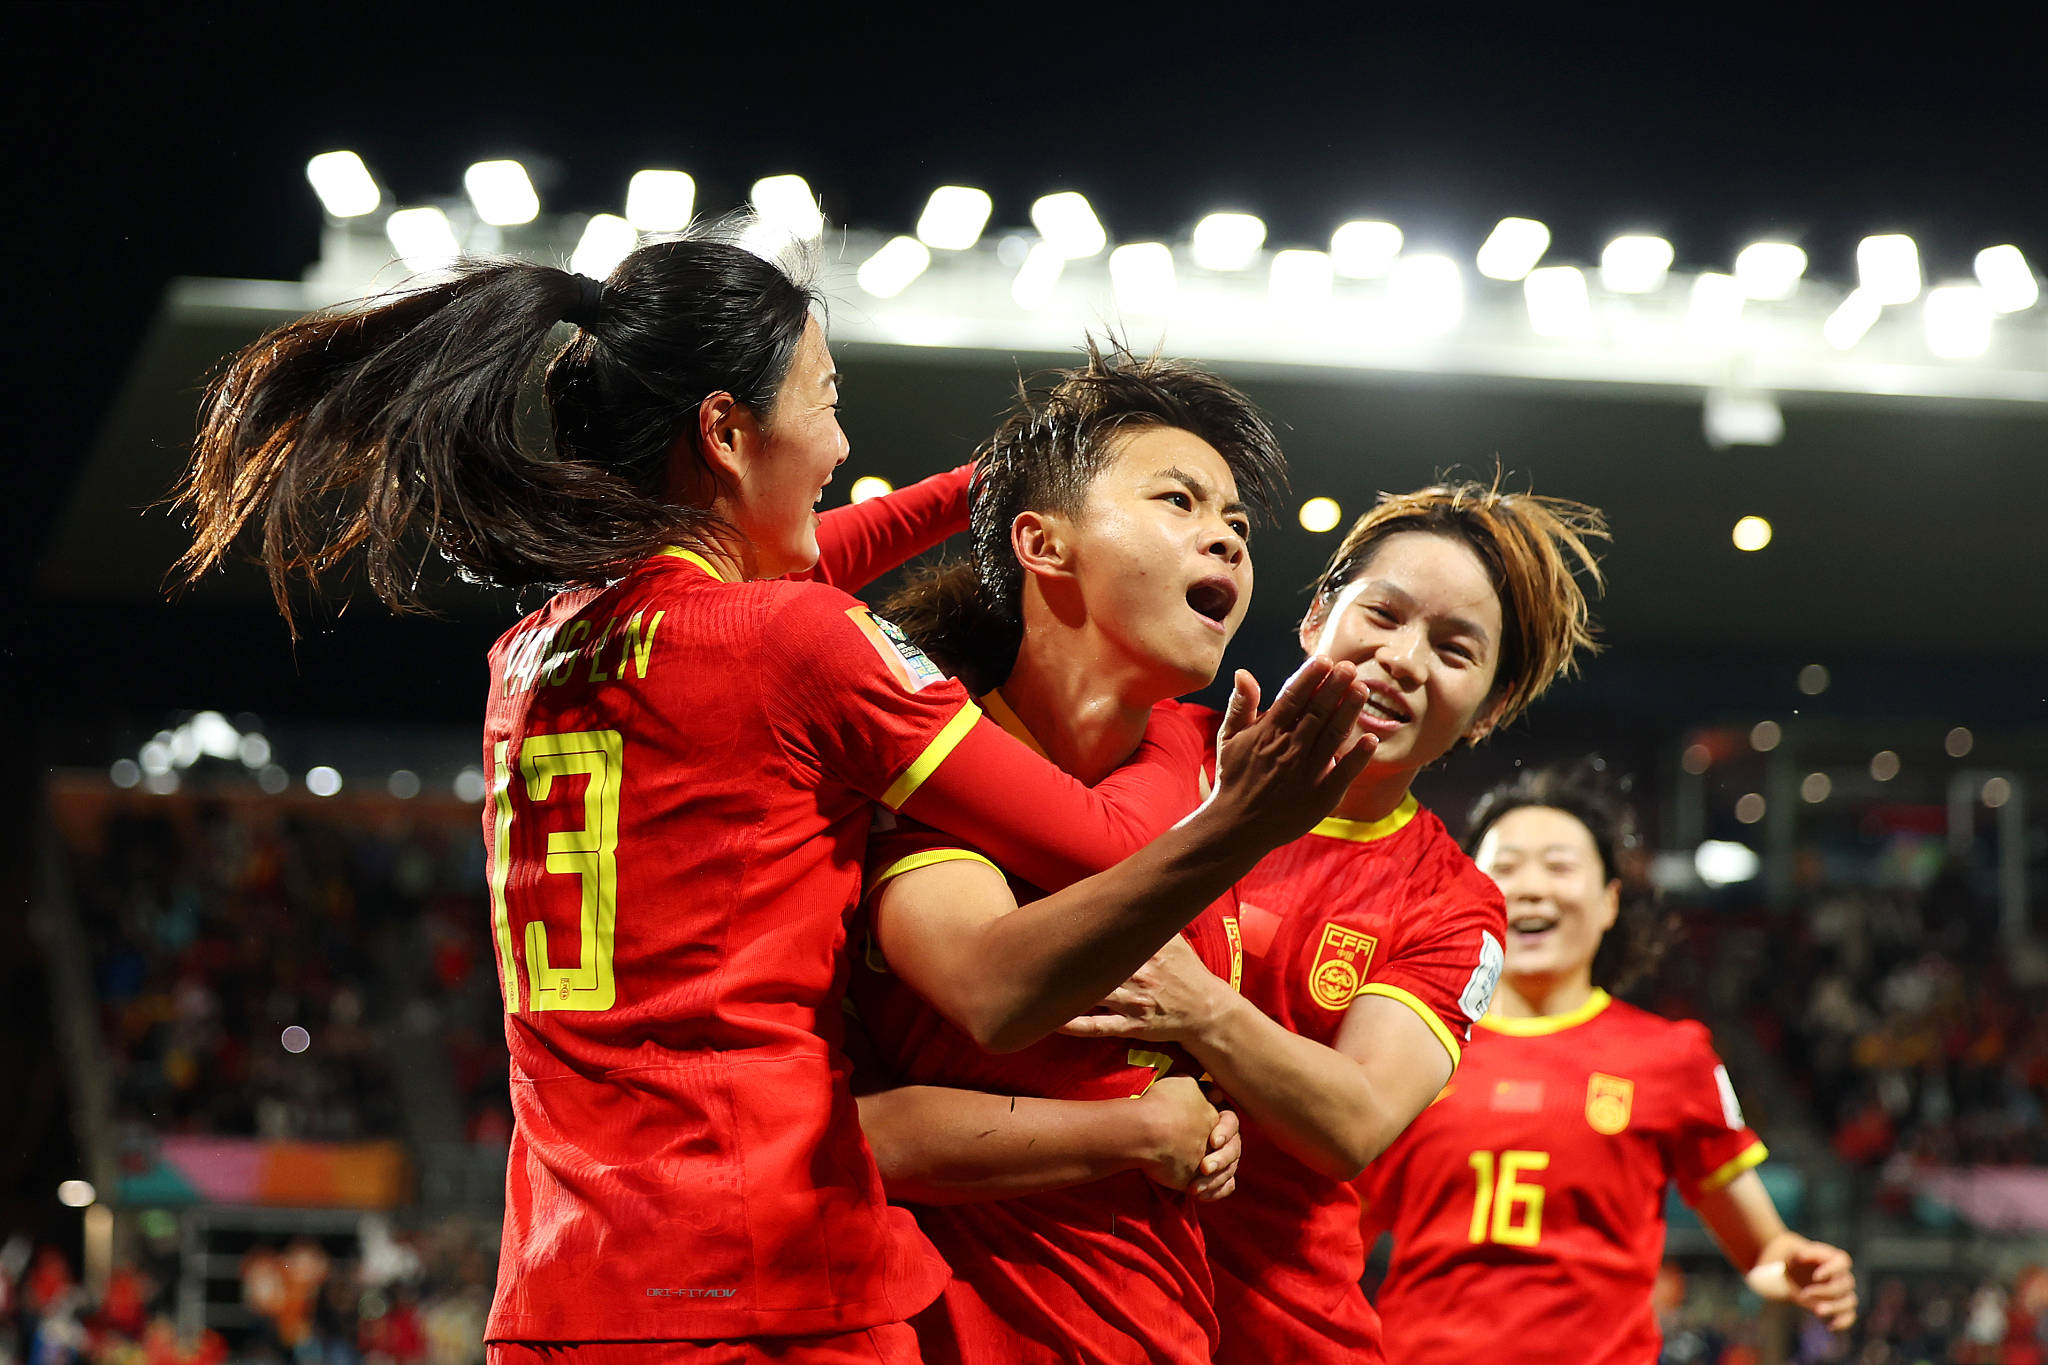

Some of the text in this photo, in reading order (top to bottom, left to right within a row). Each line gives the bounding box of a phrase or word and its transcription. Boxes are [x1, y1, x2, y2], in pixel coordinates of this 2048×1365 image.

[495, 730, 623, 1014] 13
[1327, 929, 1372, 957] CFA
[1468, 1150, 1550, 1247] 16
